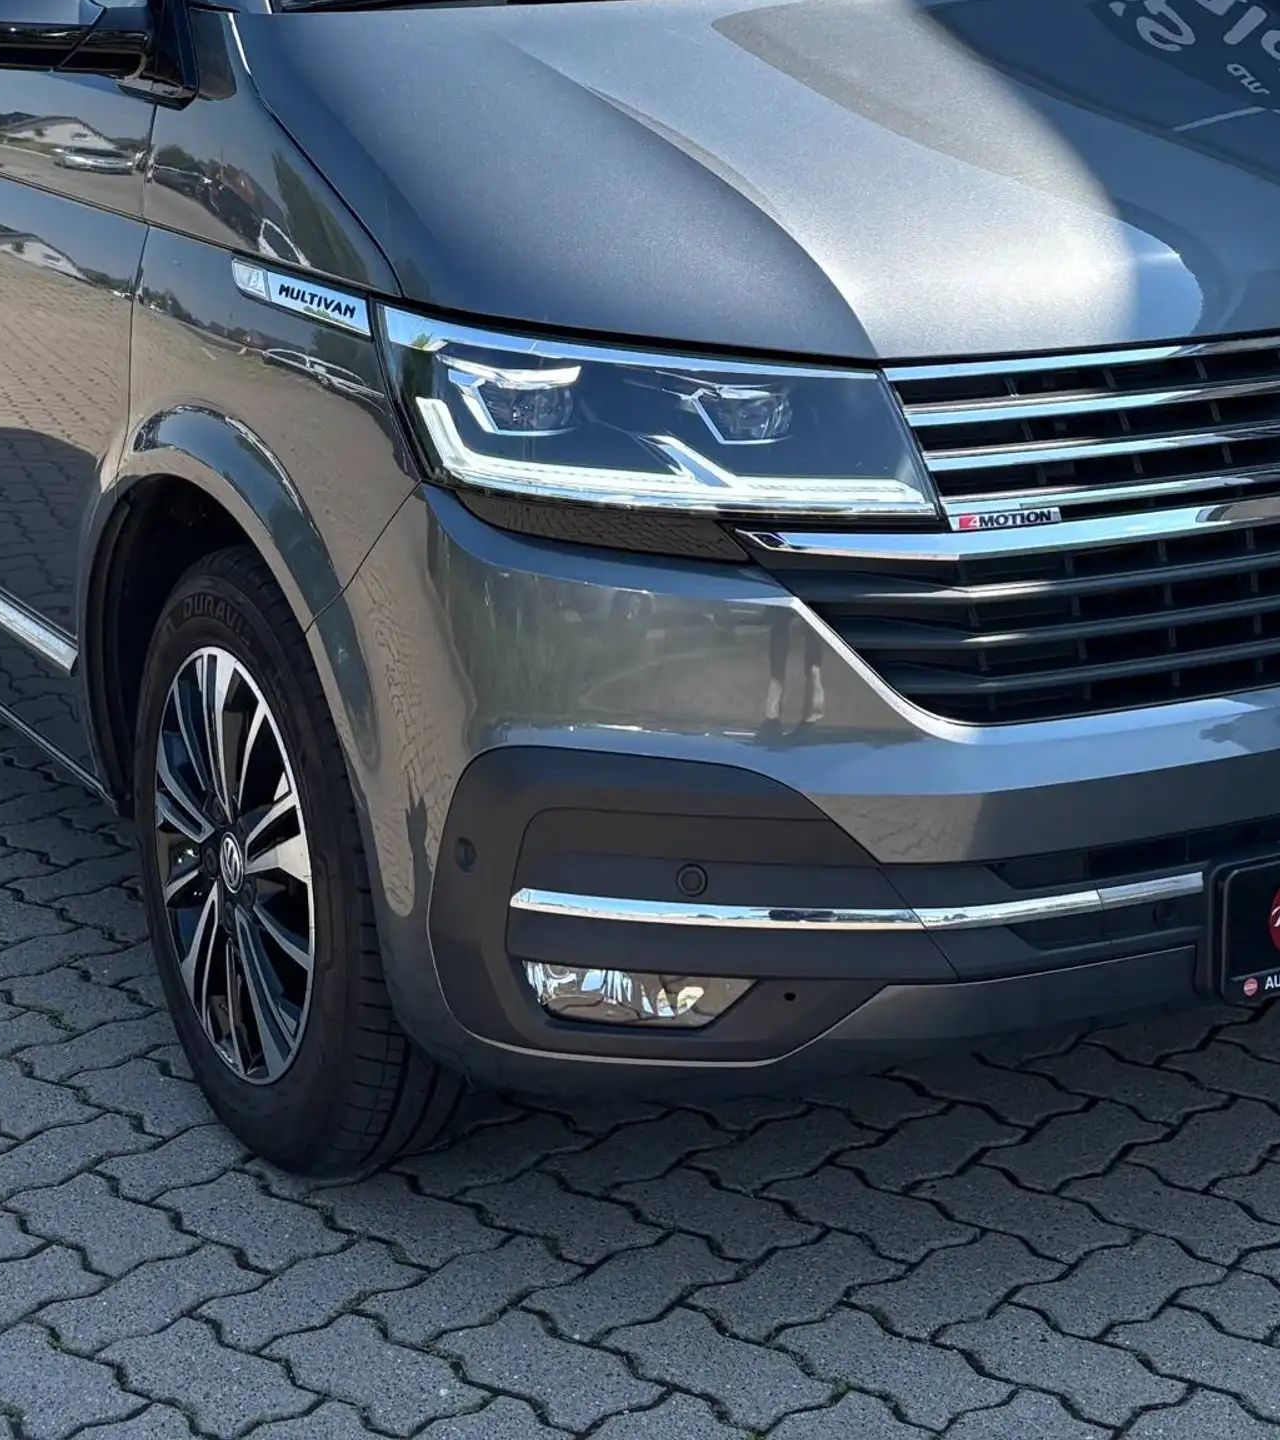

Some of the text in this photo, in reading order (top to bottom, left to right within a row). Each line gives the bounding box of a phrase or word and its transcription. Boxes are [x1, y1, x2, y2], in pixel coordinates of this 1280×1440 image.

[278, 283, 357, 319] MULTIVAN
[960, 509, 1052, 529] 4MOTION
[181, 594, 253, 646] DURAVIS
